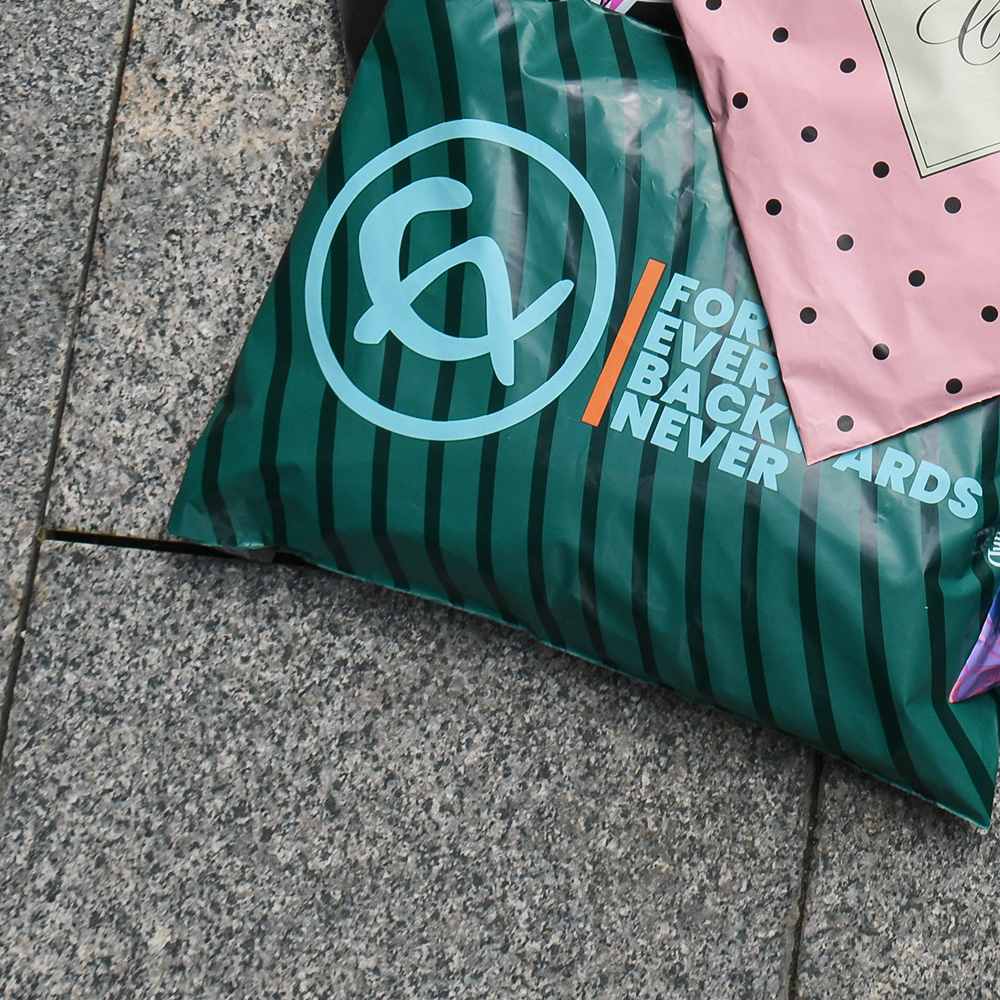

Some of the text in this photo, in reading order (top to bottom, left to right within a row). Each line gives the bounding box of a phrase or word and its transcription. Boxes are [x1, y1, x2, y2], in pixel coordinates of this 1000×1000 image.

[643, 311, 780, 396] EVER
[609, 391, 789, 491] NEVER
[627, 351, 983, 519] BACKARDS
